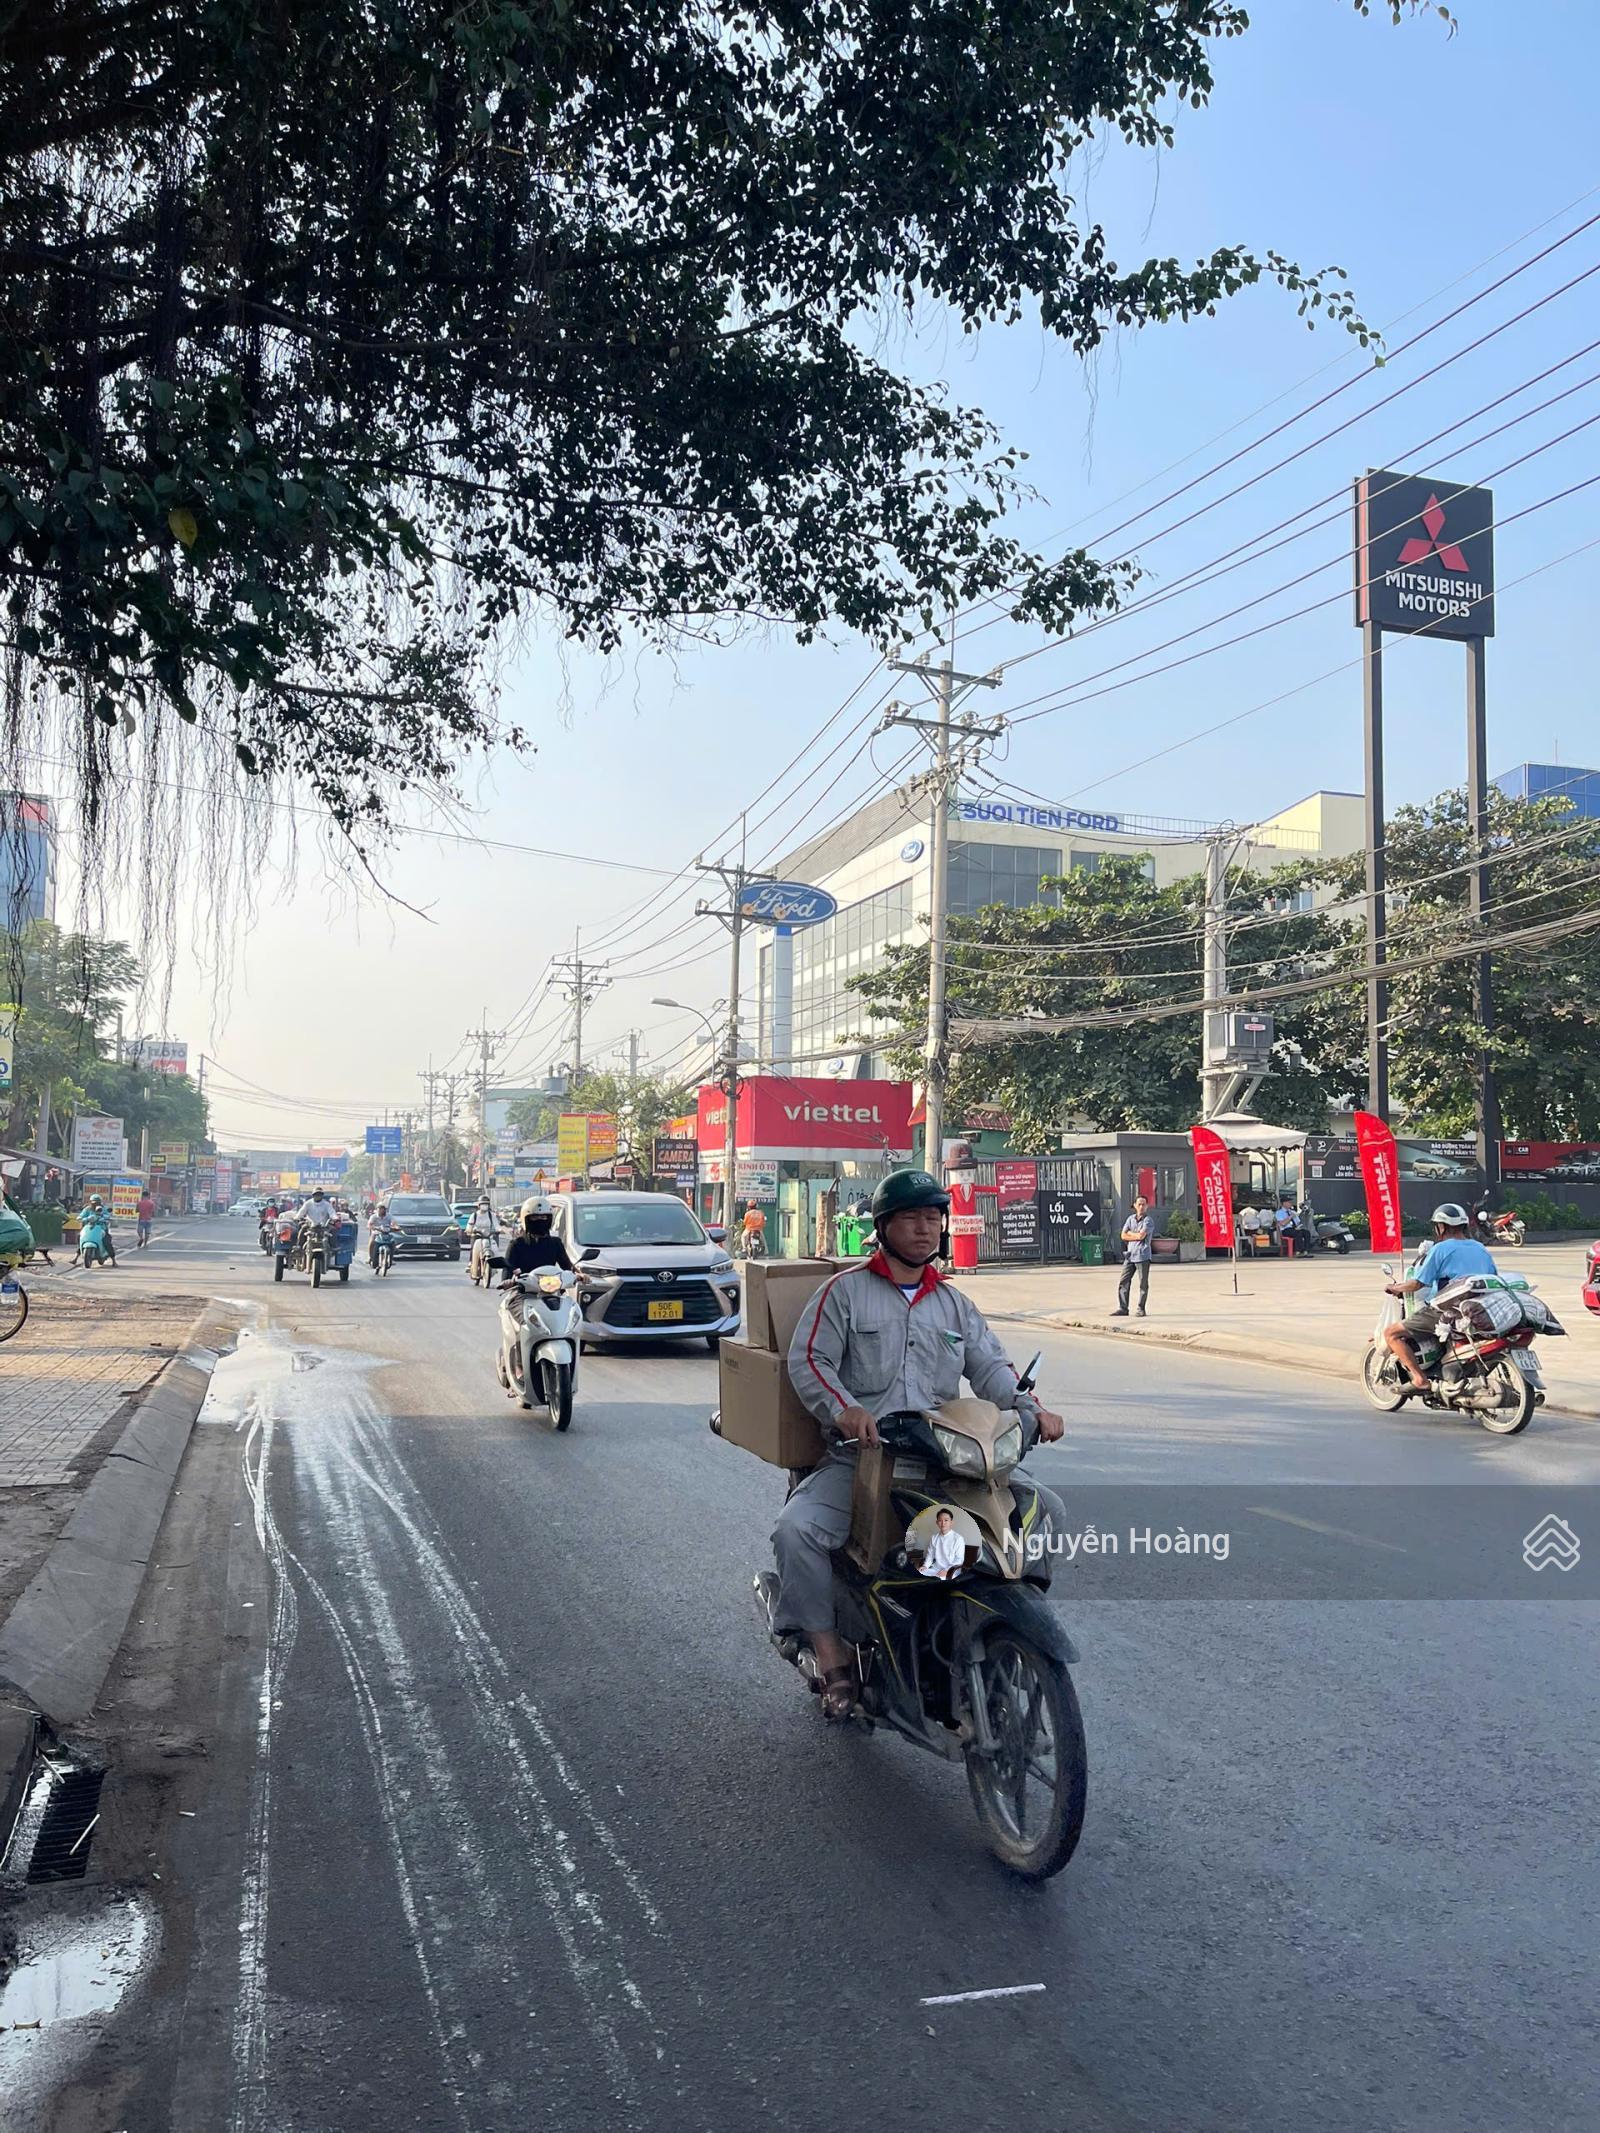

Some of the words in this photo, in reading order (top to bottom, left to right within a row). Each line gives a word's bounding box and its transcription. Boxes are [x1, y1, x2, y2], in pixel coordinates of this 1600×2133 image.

[1385, 569, 1482, 600] MITSUBISHI
[1399, 592, 1471, 617] MOTORS
[1067, 812, 1119, 831] FORD
[754, 889, 817, 917] Ford
[784, 1101, 882, 1124] viettel
[658, 1150, 694, 1162] CAMERA
[1049, 1201, 1064, 1212] LỐI
[1204, 1177, 1218, 1225] CROSS
[1211, 1160, 1228, 1234] XPANDER
[1373, 1151, 1396, 1237] TRITON
[1050, 1213, 1069, 1224] VÀO
